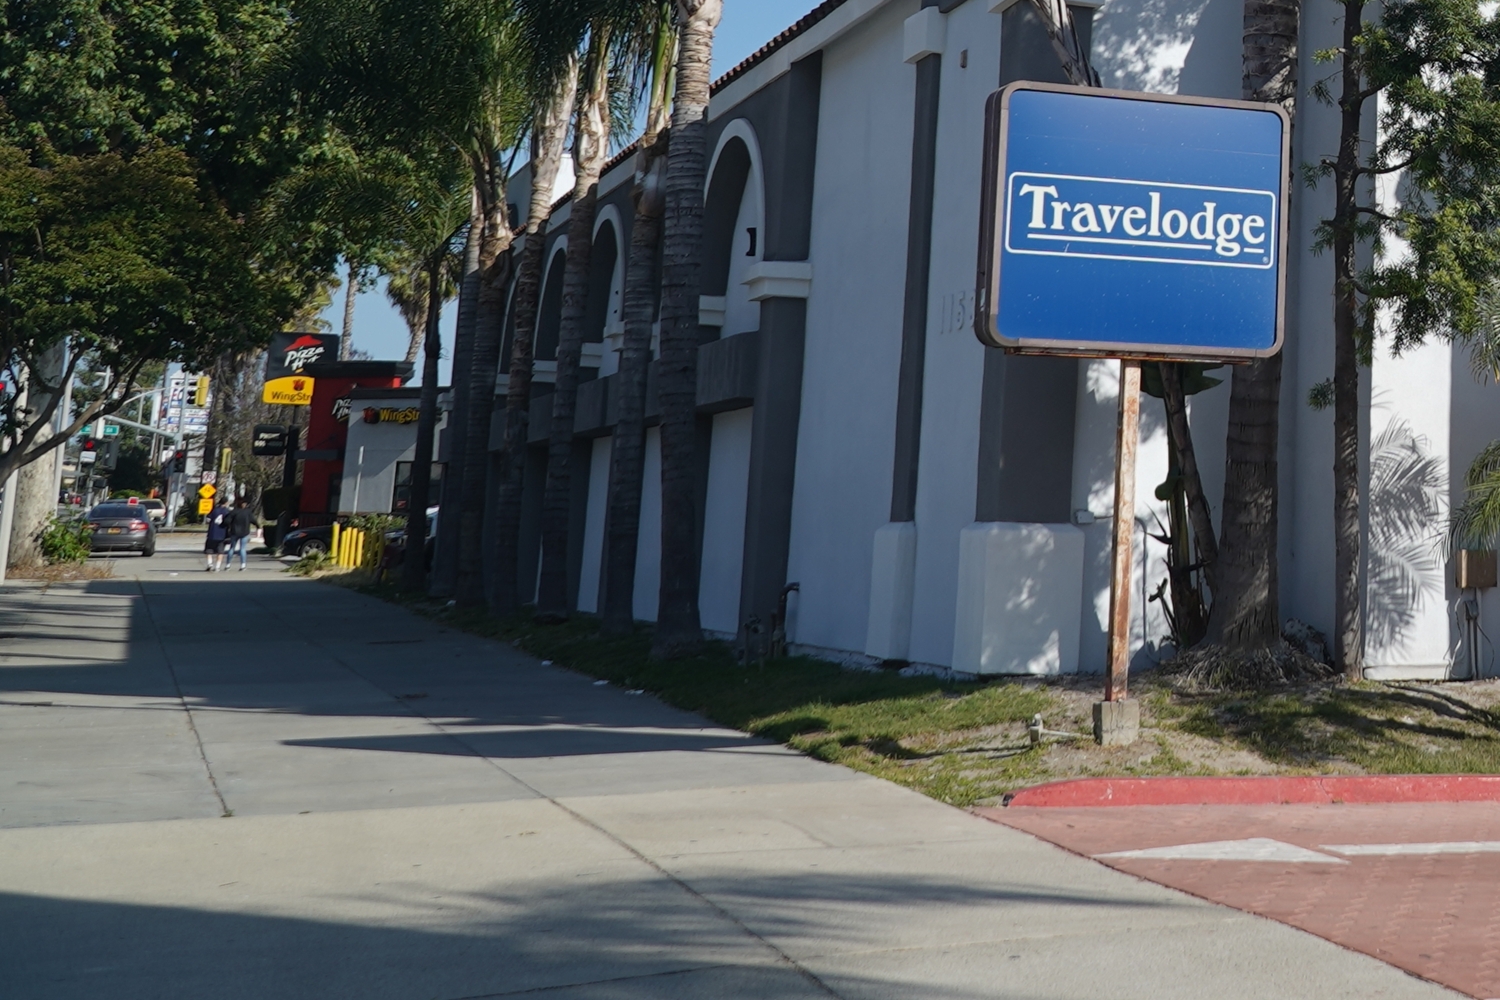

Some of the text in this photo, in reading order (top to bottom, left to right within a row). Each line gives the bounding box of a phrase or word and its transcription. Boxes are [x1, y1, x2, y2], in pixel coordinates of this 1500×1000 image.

[1019, 183, 1265, 257] Travelodge
[284, 346, 325, 367] Pizza
[272, 391, 311, 402] WingStr
[380, 407, 420, 424] WingStr
